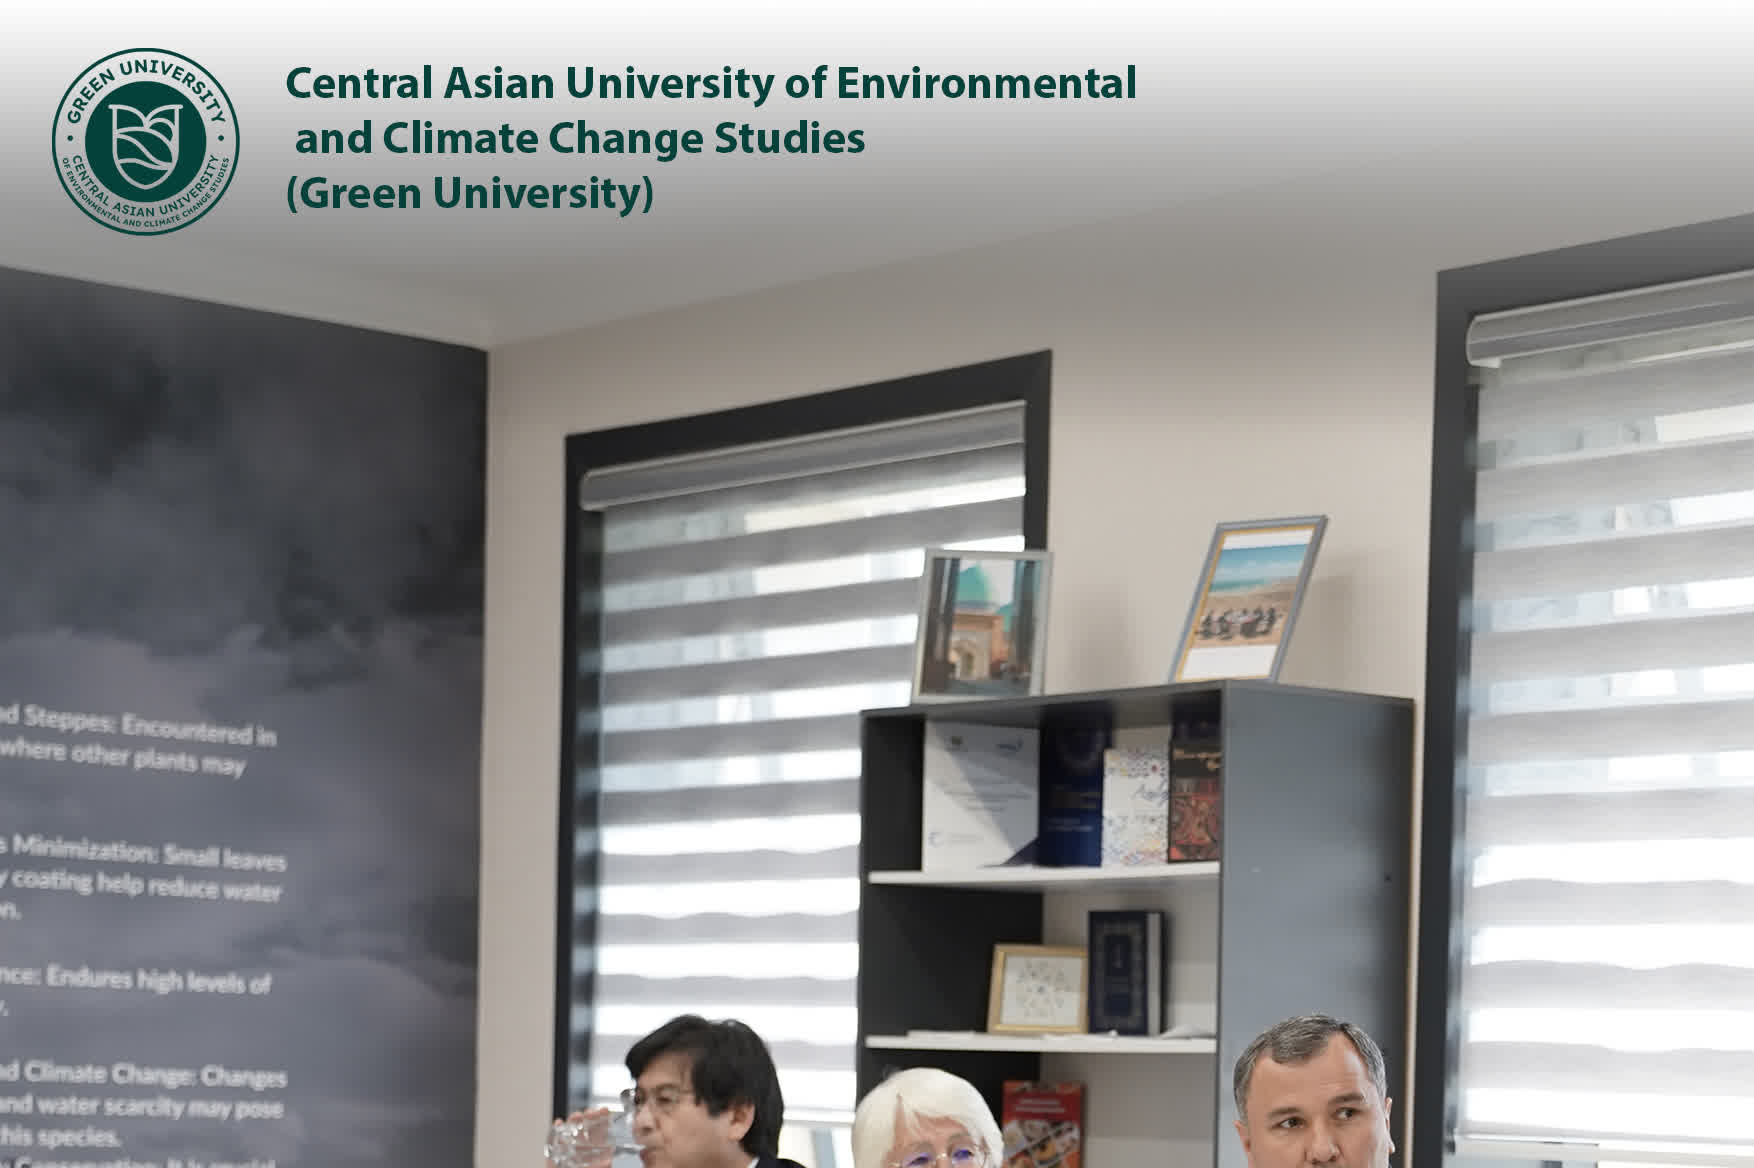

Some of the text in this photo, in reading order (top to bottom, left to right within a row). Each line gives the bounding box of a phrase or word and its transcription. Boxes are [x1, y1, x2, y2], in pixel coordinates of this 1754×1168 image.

[0, 702, 277, 748] nd Steppes: Encountered in
[0, 736, 246, 780] where other plants may
[13, 833, 158, 864] Minimization:
[163, 842, 220, 868] Small
[223, 848, 288, 873] leaves
[12, 869, 93, 896] coating
[96, 870, 144, 898] help
[148, 874, 219, 900] reduce
[223, 882, 284, 903] water
[47, 963, 133, 989] Endures
[138, 968, 183, 995] high
[187, 970, 246, 994] levels
[249, 972, 272, 995] of
[0, 1059, 288, 1091] nd Climate Change: Changes
[37, 1097, 99, 1115] water
[103, 1095, 185, 1120] scarcity
[187, 1099, 233, 1121] may
[234, 1100, 285, 1121] pose
[0, 1125, 123, 1150] his species.
